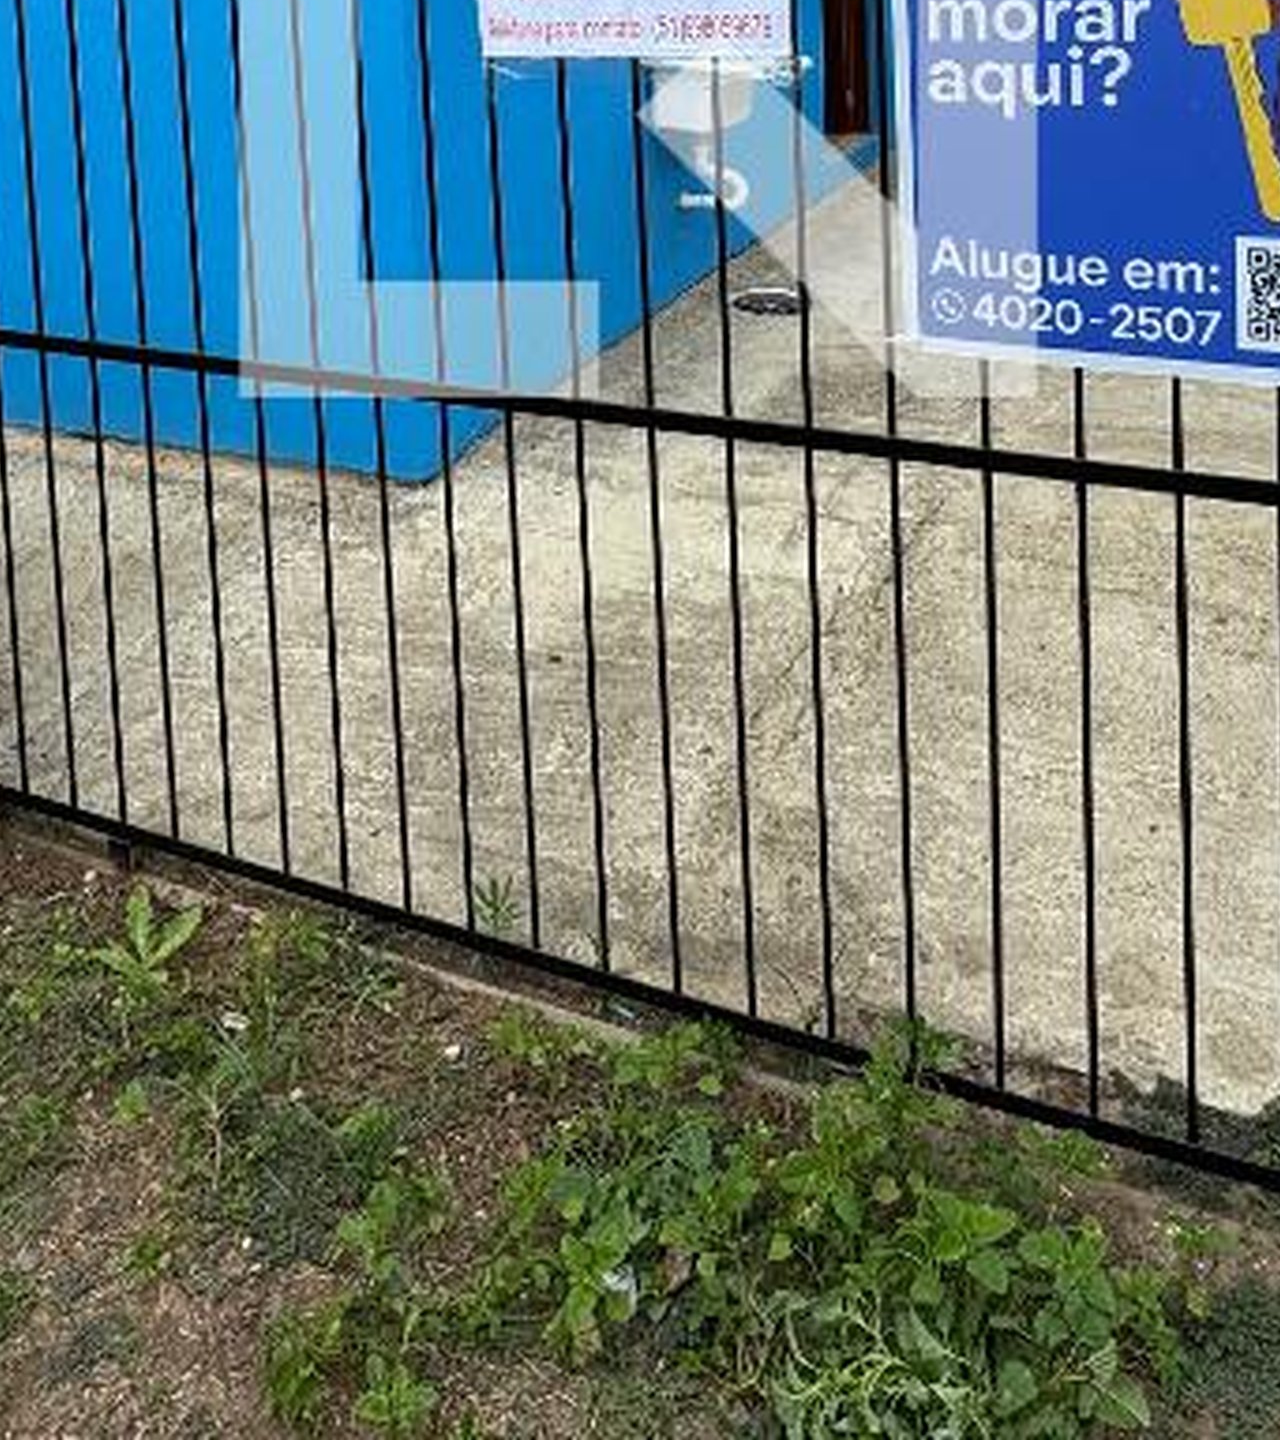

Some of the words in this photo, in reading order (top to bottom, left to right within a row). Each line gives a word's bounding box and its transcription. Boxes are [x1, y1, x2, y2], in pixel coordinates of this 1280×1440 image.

[927, 44, 1133, 120] aqui?
[929, 236, 1110, 293] Alugue
[1122, 257, 1222, 295] em:
